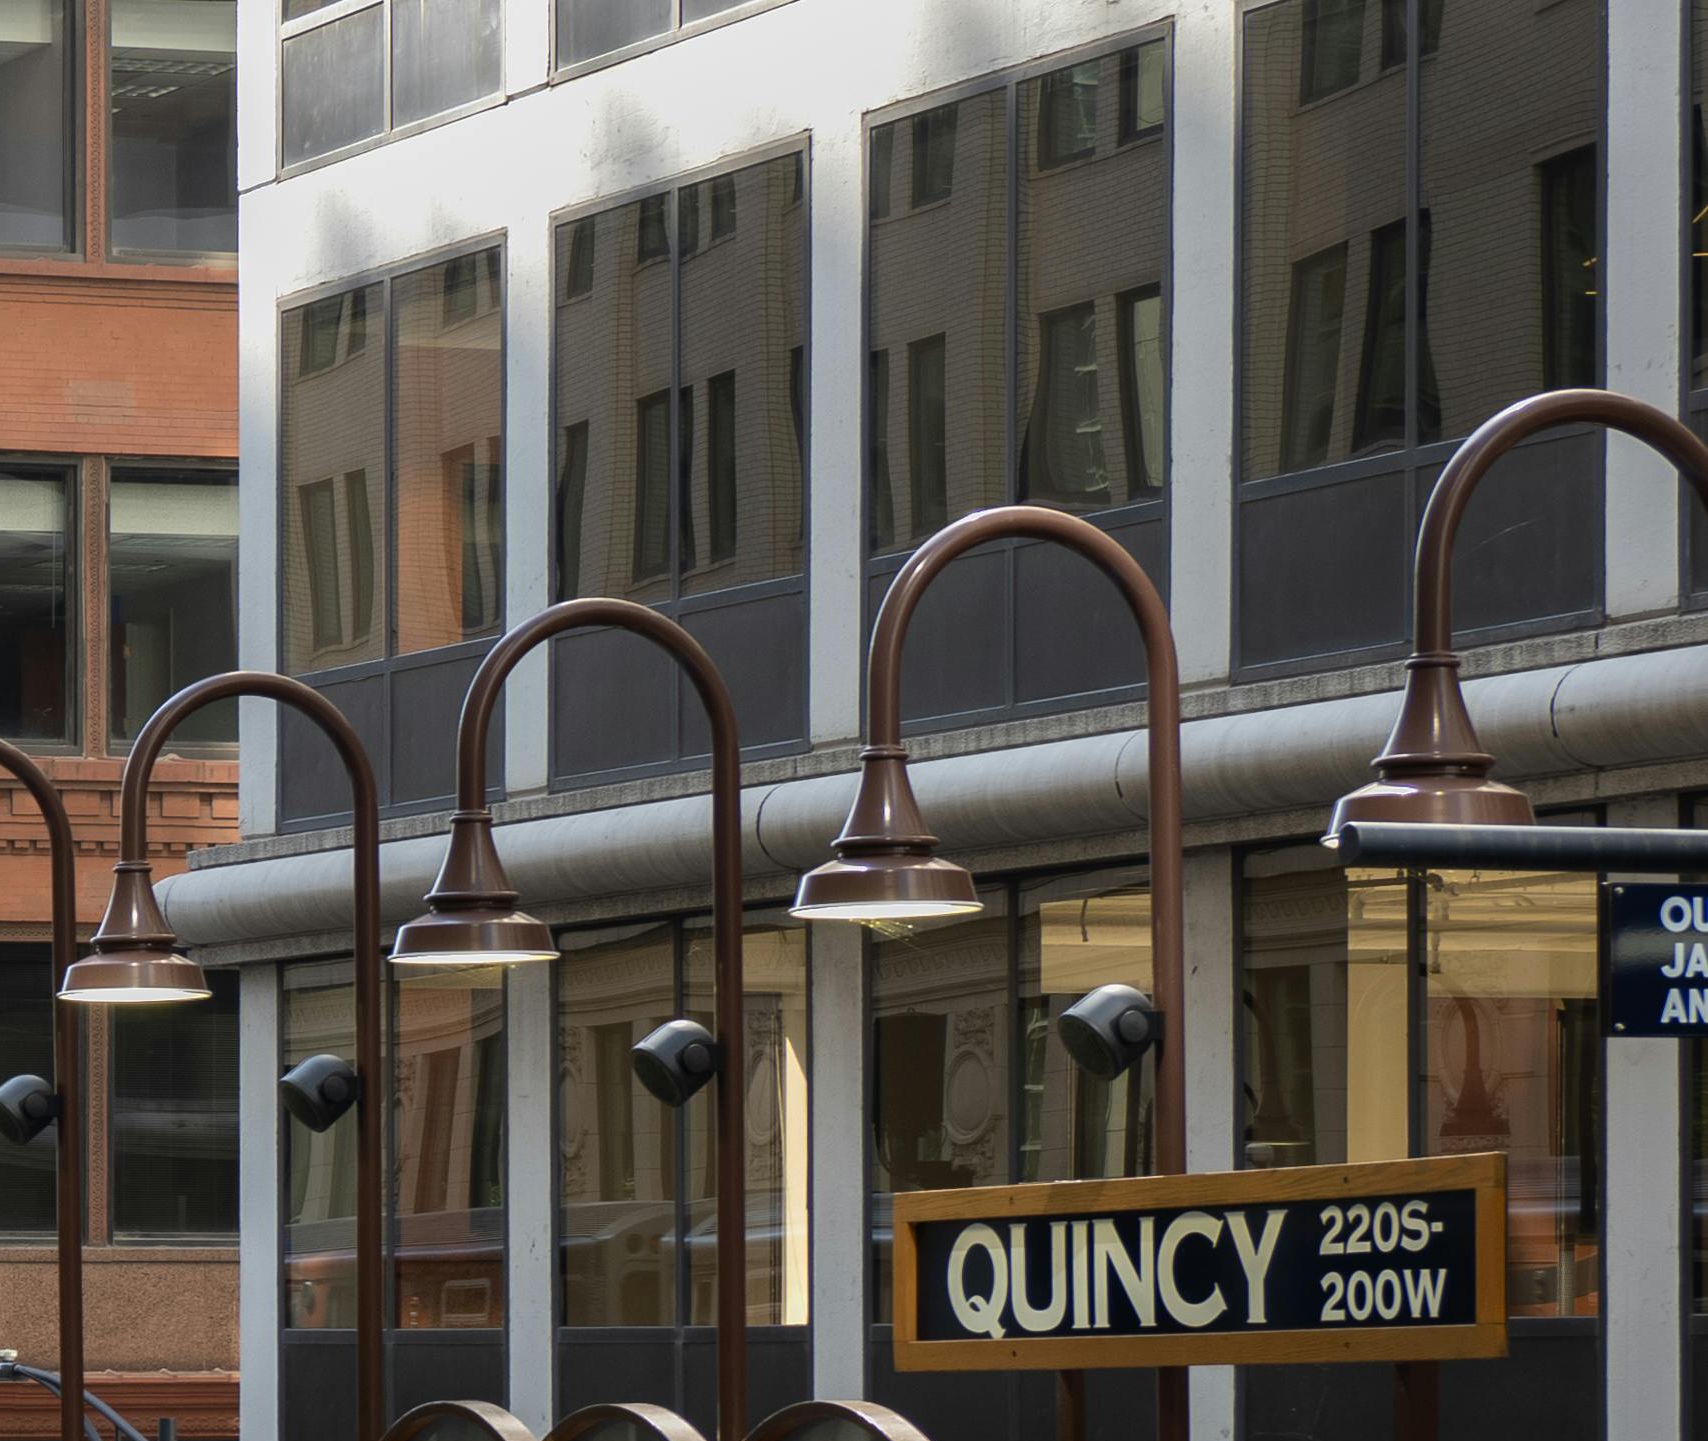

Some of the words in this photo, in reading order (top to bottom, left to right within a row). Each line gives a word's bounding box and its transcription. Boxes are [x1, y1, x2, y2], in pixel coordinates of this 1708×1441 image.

[947, 1210, 1288, 1339] QUINCY
[1319, 1200, 1445, 1256] 220S-
[1320, 1268, 1447, 1322] 200W
